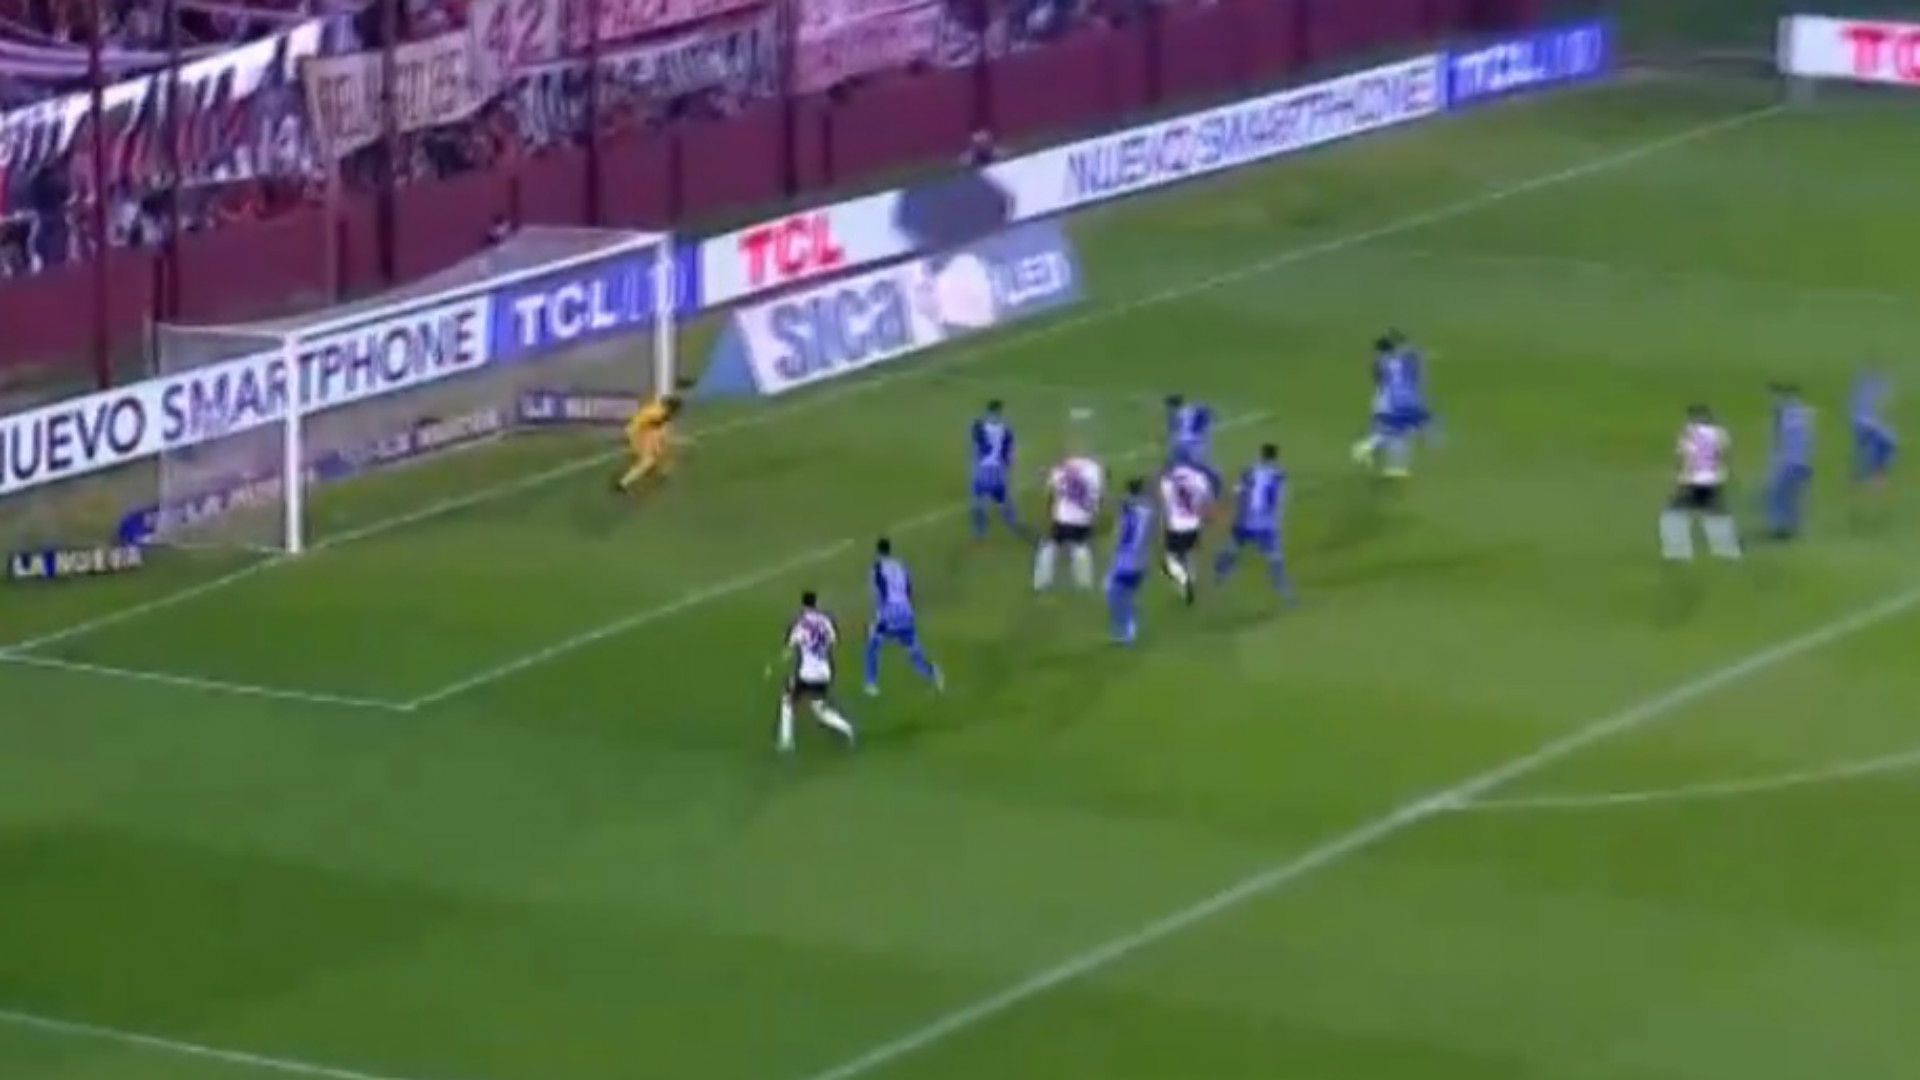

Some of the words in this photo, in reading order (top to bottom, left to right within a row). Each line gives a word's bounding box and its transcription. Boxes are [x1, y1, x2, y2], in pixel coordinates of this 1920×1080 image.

[737, 213, 842, 286] TCL
[516, 282, 617, 345] TCL
[0, 396, 146, 484] UEVO
[162, 310, 475, 441] SMARTPHONE
